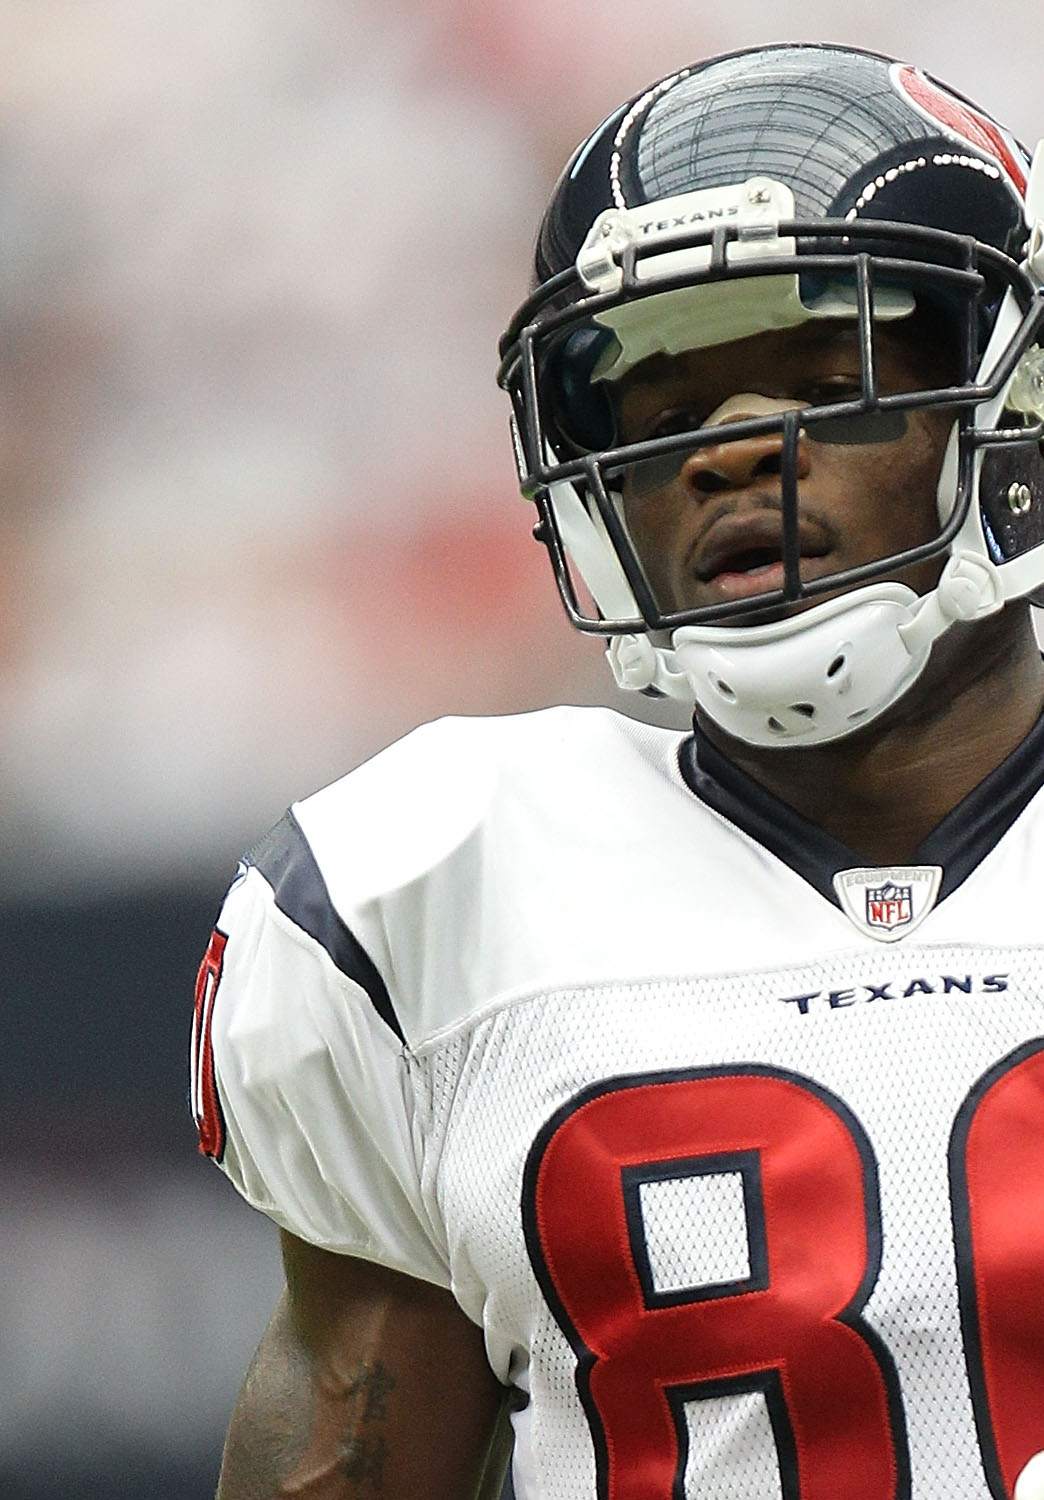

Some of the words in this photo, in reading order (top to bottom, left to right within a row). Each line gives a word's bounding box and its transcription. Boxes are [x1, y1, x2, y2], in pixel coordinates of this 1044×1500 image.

[639, 204, 740, 234] TEXANS
[846, 870, 929, 887] EQUIPMENT
[868, 901, 909, 924] NFL
[778, 973, 1010, 1015] TEXANS
